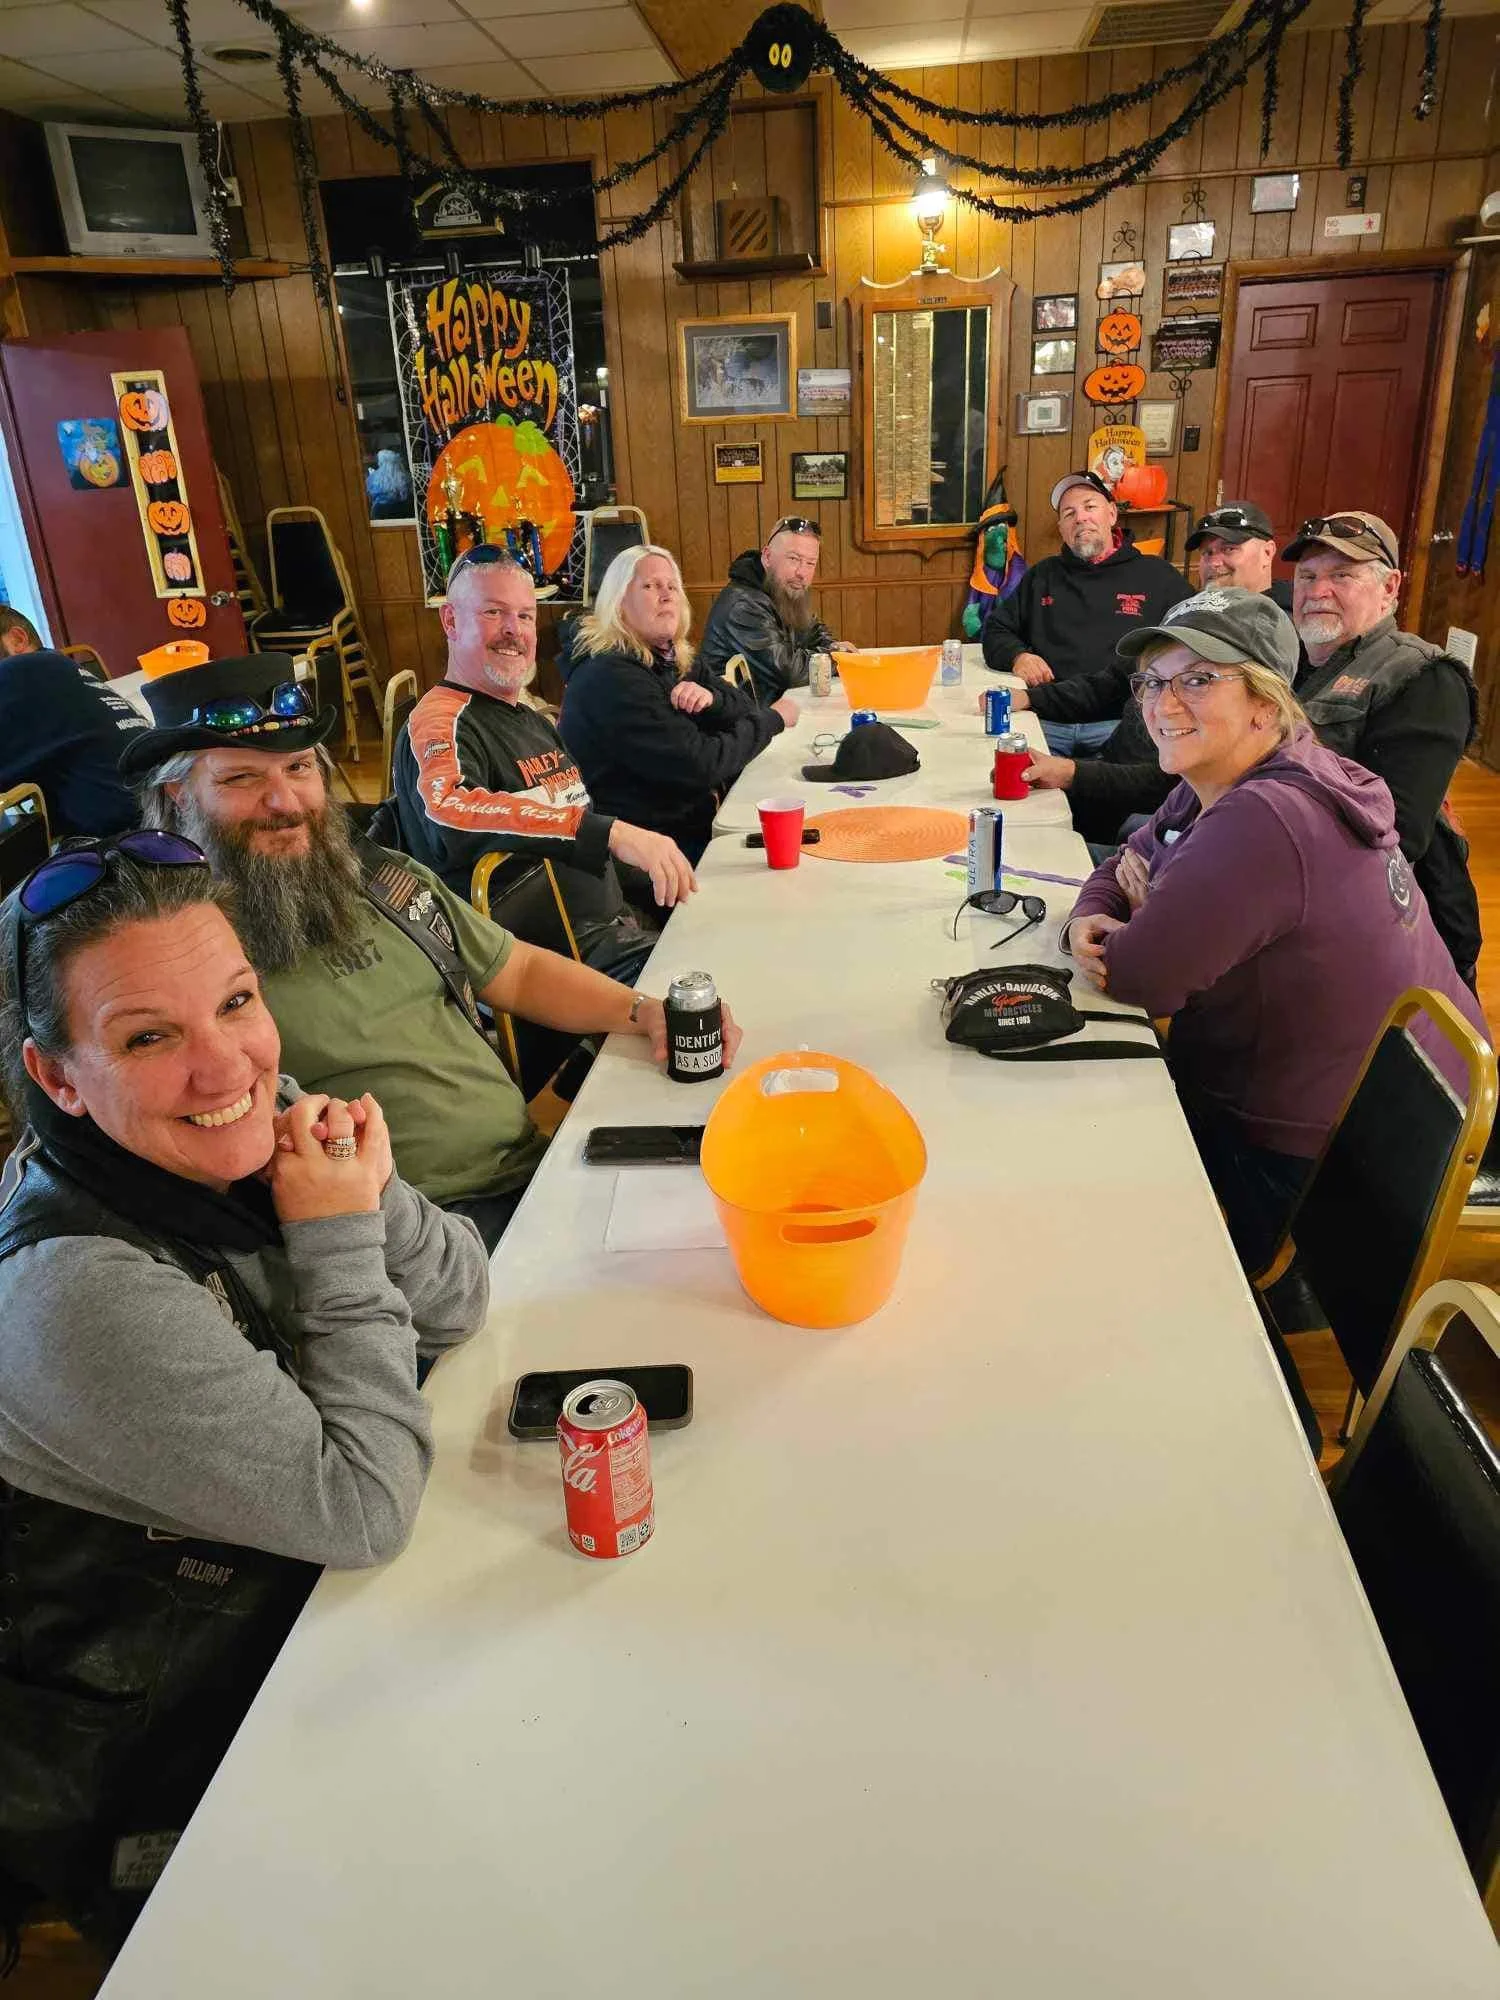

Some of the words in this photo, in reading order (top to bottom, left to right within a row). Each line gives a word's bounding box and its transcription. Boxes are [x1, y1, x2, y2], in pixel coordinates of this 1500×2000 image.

[427, 277, 531, 362] Happy
[1094, 437, 1141, 449] Halloween
[1105, 428, 1135, 440] Happy
[440, 796, 512, 816] Davidson
[519, 804, 569, 823] USA
[968, 839, 977, 885] ULTRA
[983, 1003, 1043, 1018] MOTORCYCLES
[699, 1018, 704, 1031] I
[998, 1017, 1015, 1026] SINCE
[675, 1027, 721, 1049] IDENTIFY
[677, 1054, 689, 1068] AS
[692, 1057, 700, 1069] A
[703, 1051, 723, 1067] SOD
[176, 1556, 234, 1587] DILLIGAF
